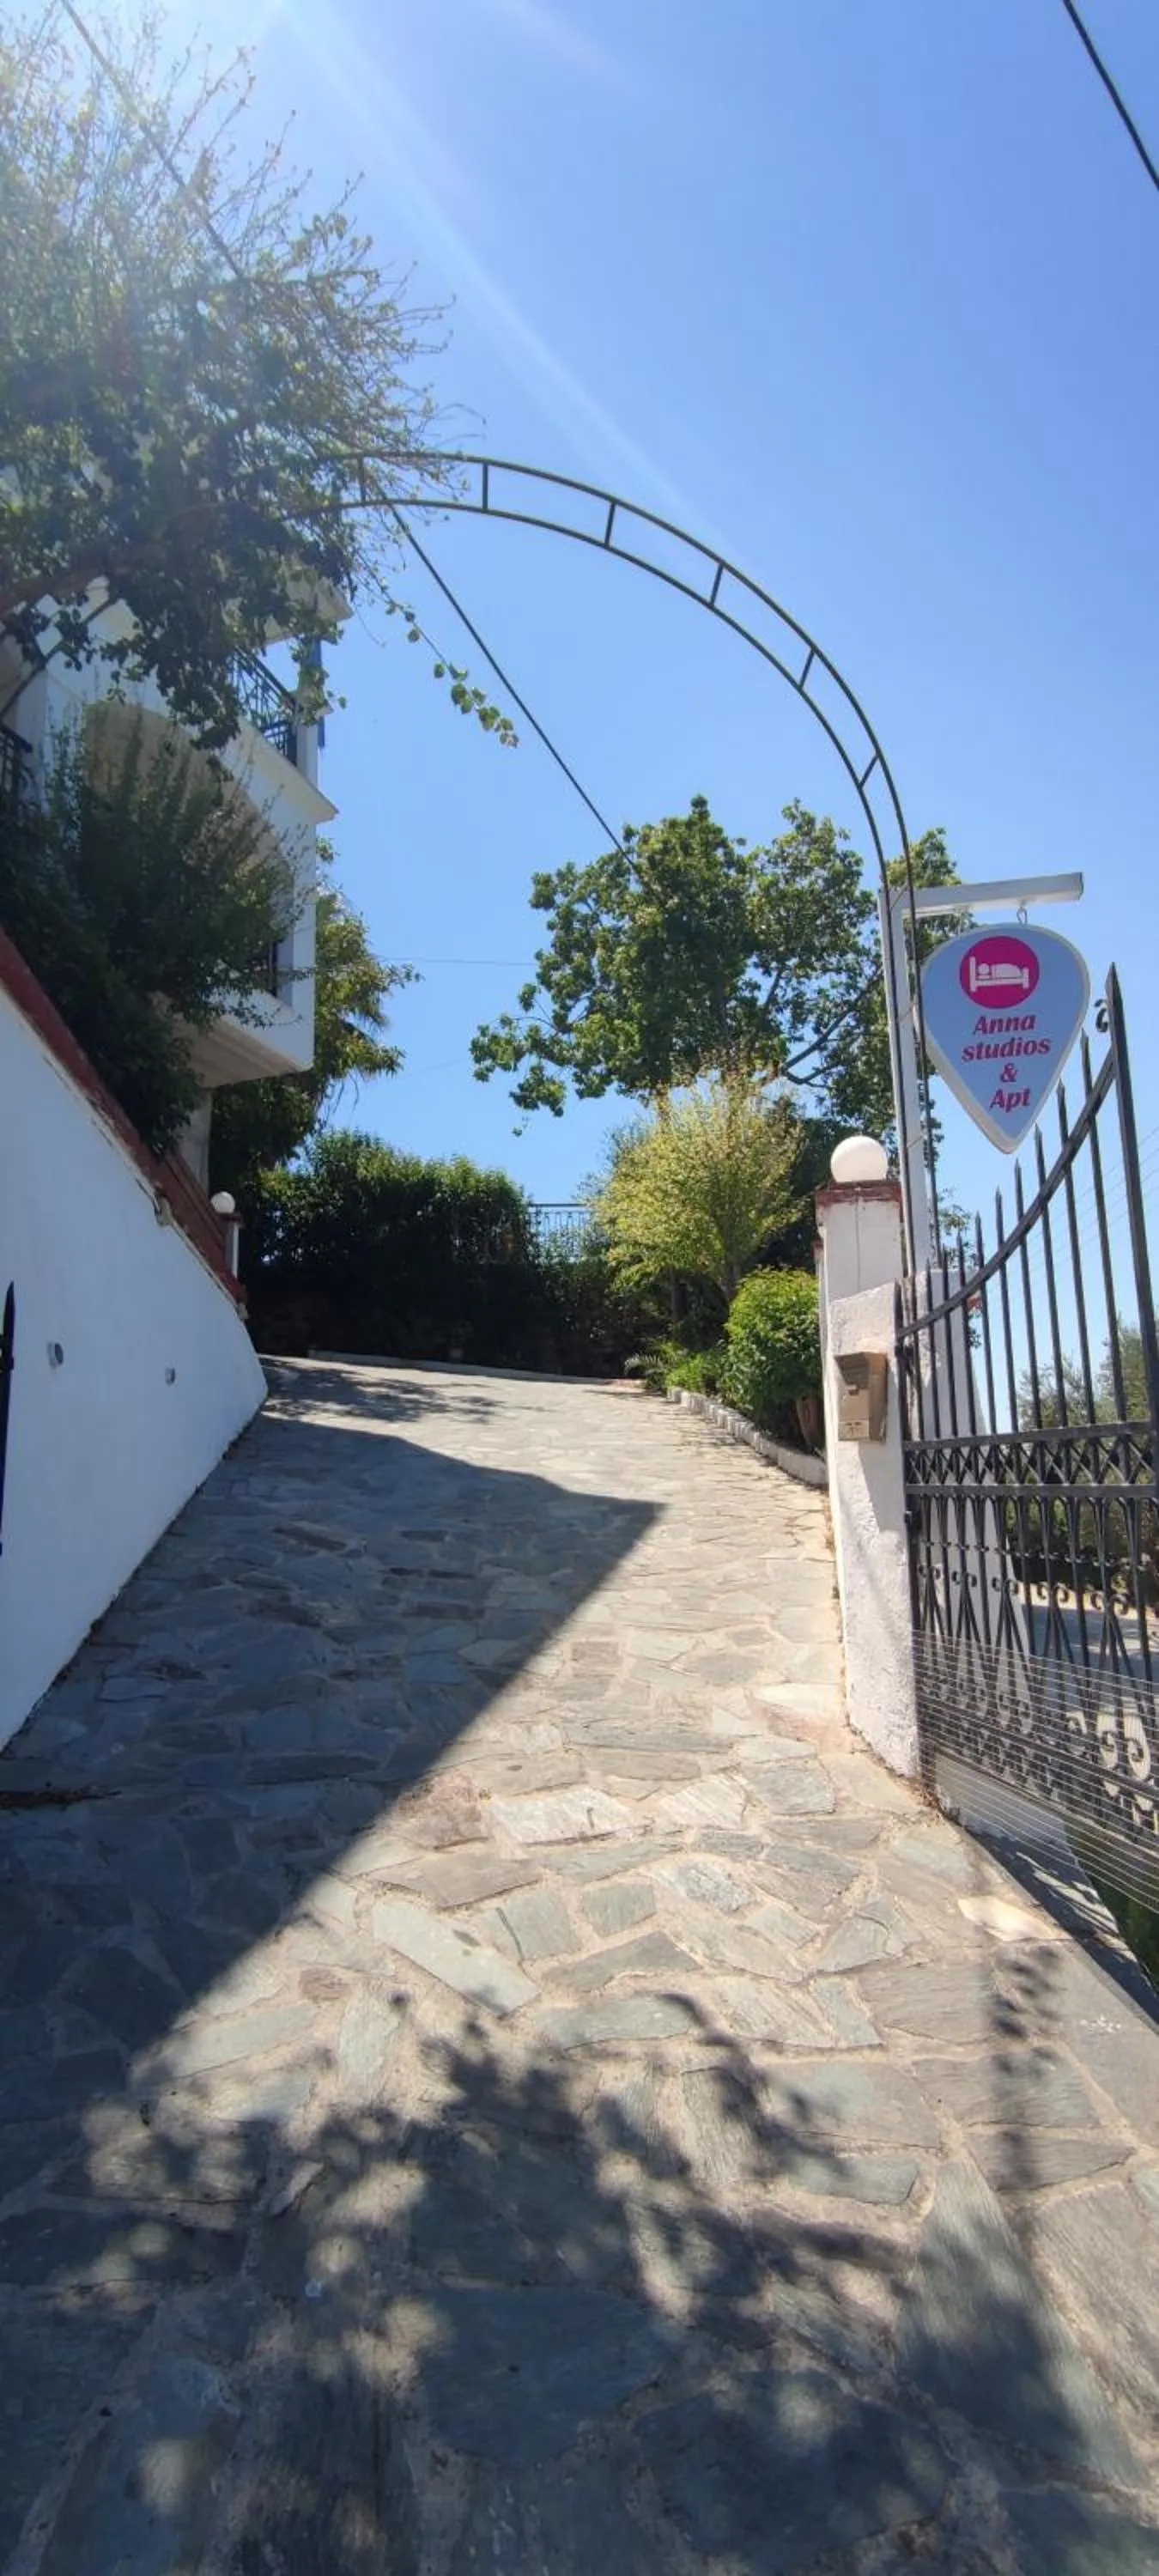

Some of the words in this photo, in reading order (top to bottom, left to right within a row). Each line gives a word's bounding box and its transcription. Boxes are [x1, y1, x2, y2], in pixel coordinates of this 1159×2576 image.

[974, 1014, 1036, 1036] Anna
[961, 1036, 1052, 1062] studios
[999, 1062, 1018, 1083] &
[990, 1088, 1031, 1113] Apt
